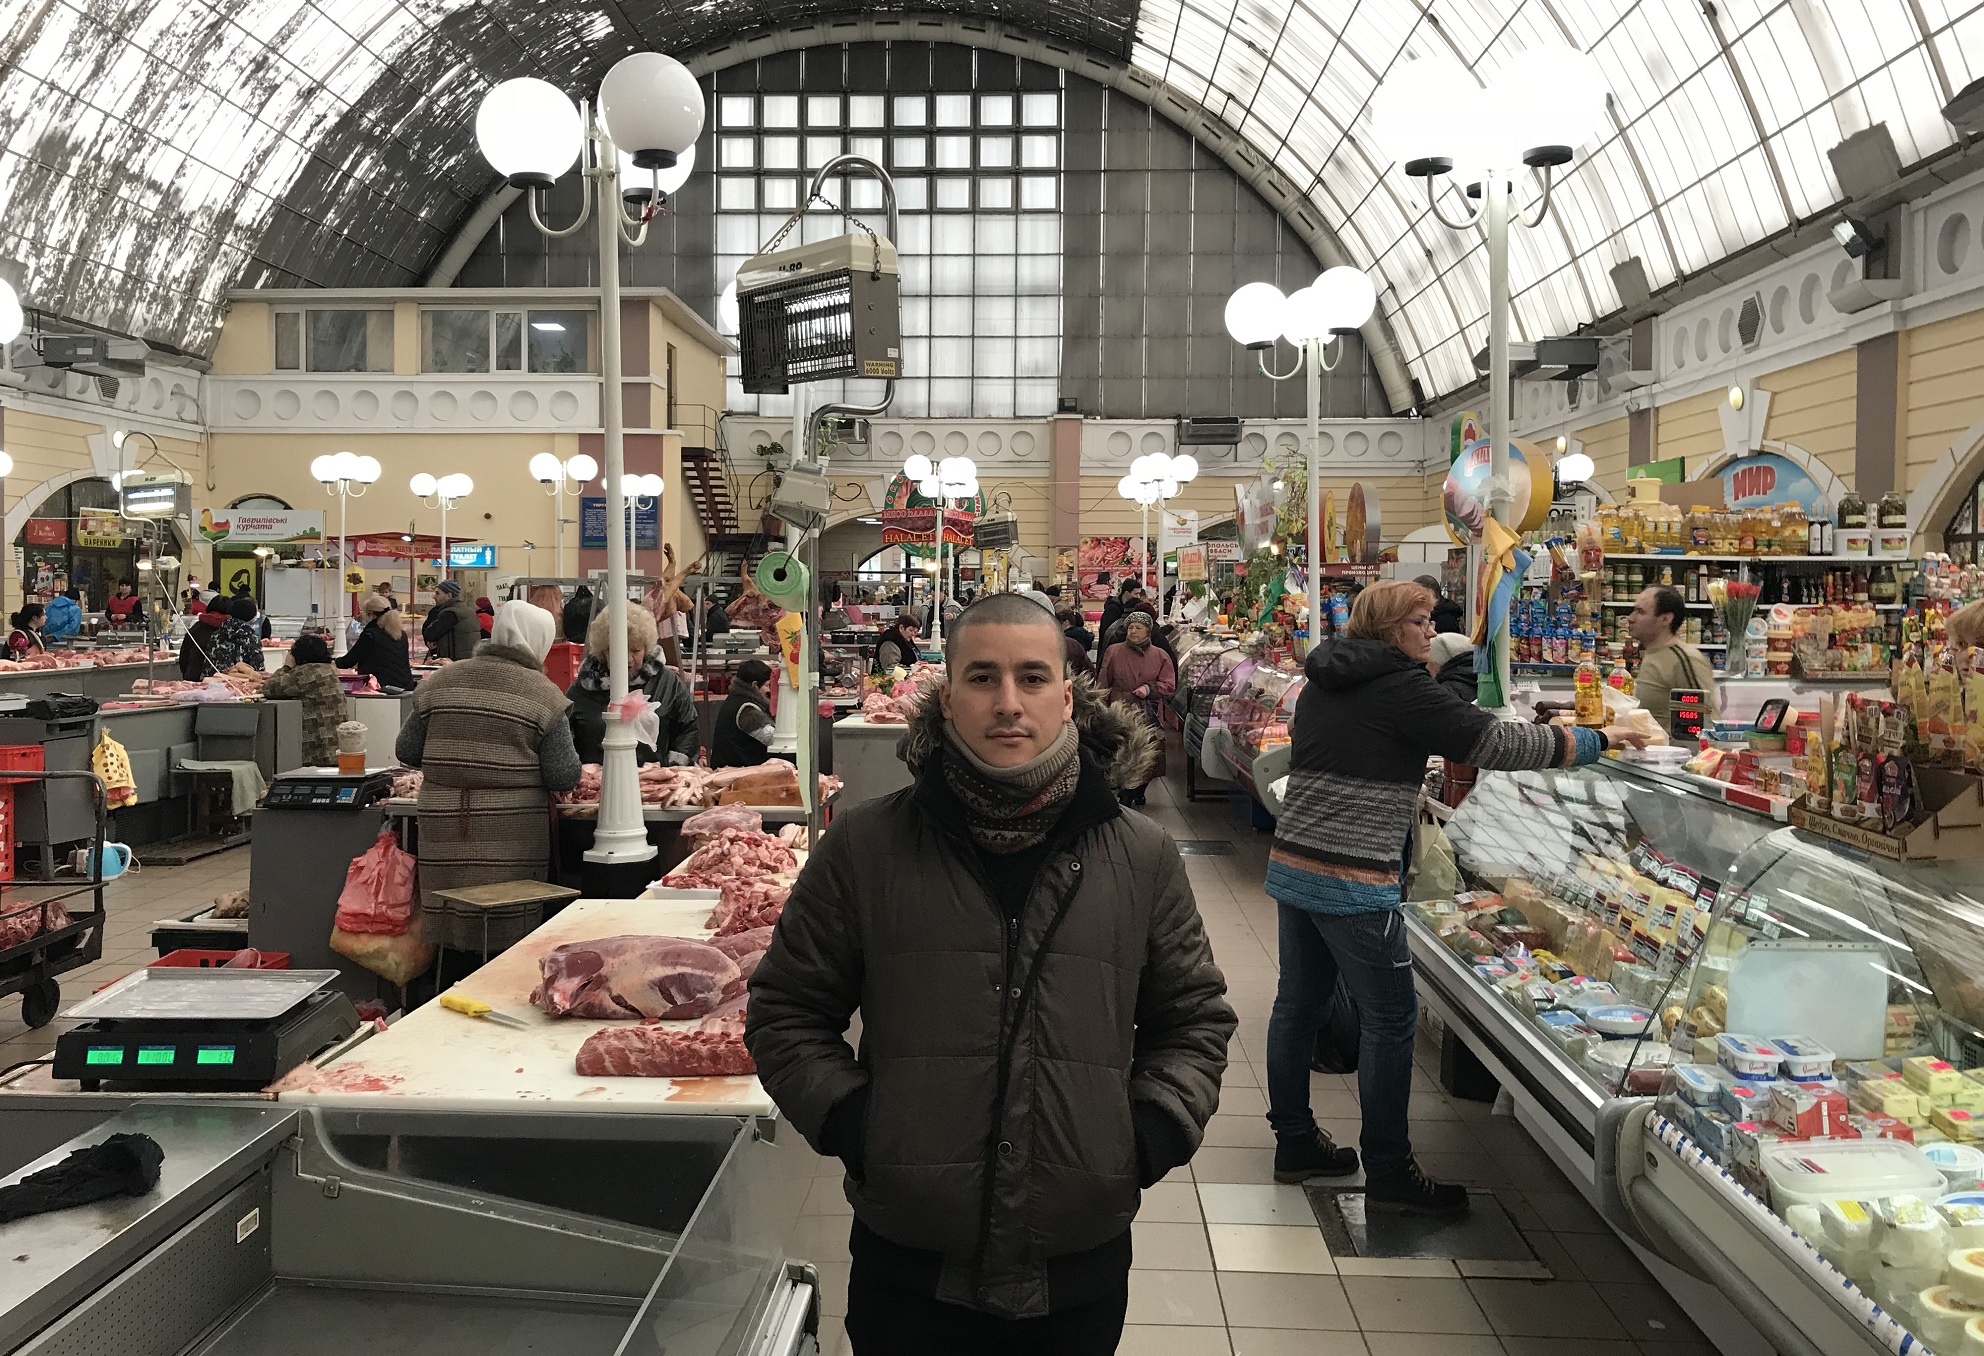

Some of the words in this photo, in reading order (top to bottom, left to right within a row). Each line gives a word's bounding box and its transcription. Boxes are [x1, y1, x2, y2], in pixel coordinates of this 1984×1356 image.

[880, 368, 895, 376] Volts
[1732, 465, 1776, 502] МИР
[885, 533, 920, 542] HALAL
[84, 538, 116, 547] ВАРЕНИКИ
[450, 546, 482, 554] ЛАТНЫЙ
[1808, 815, 1831, 834] Щедро,
[1832, 823, 1860, 843] Смачно,
